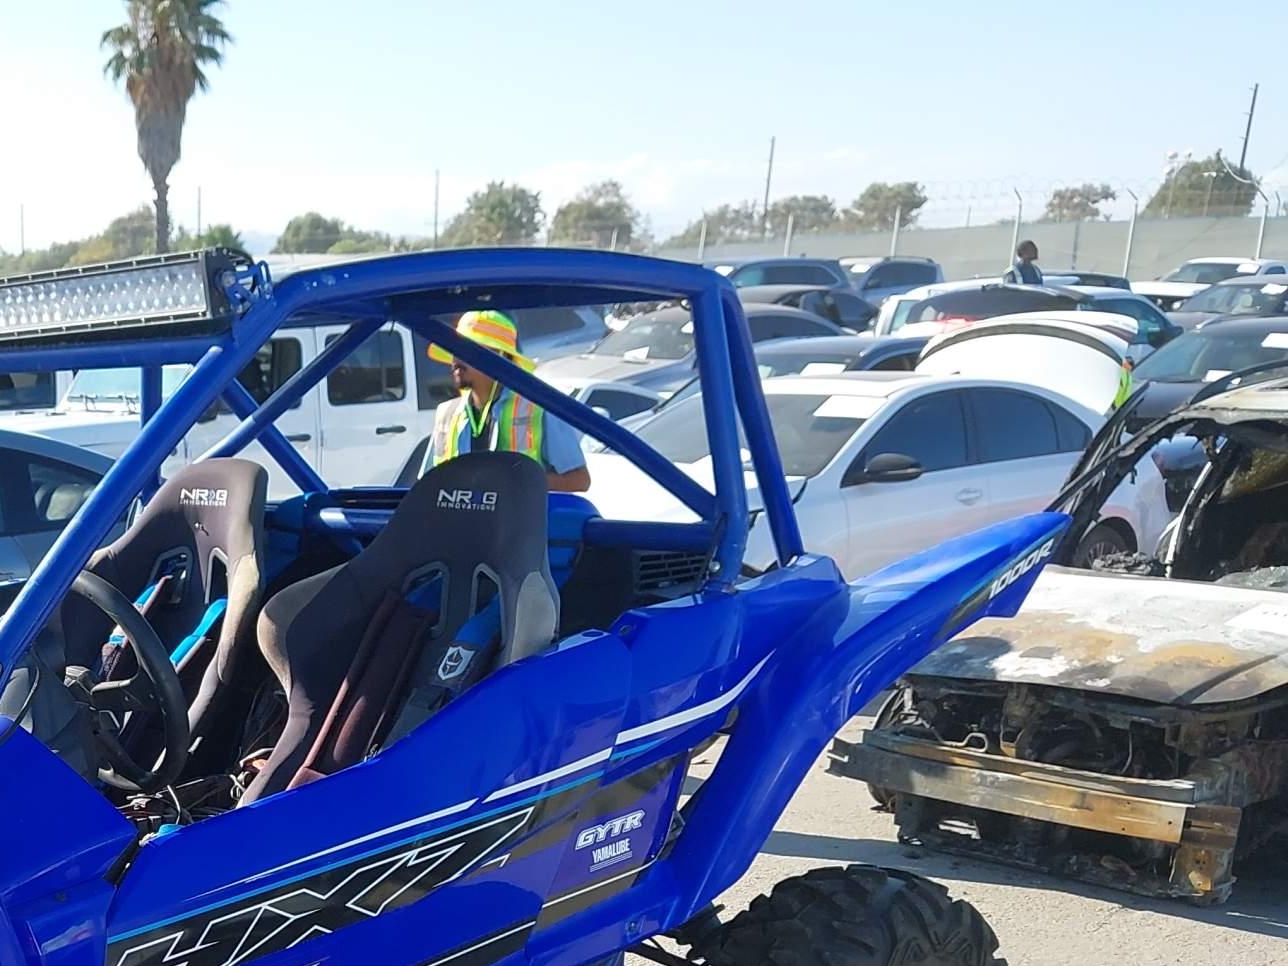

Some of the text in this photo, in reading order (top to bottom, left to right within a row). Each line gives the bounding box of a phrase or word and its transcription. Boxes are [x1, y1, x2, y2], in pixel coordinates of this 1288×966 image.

[436, 501, 496, 512] INNOVATIONS
[988, 538, 1054, 600] 1000R
[575, 809, 646, 851] GYTR
[592, 838, 631, 863] YAMALUBE
